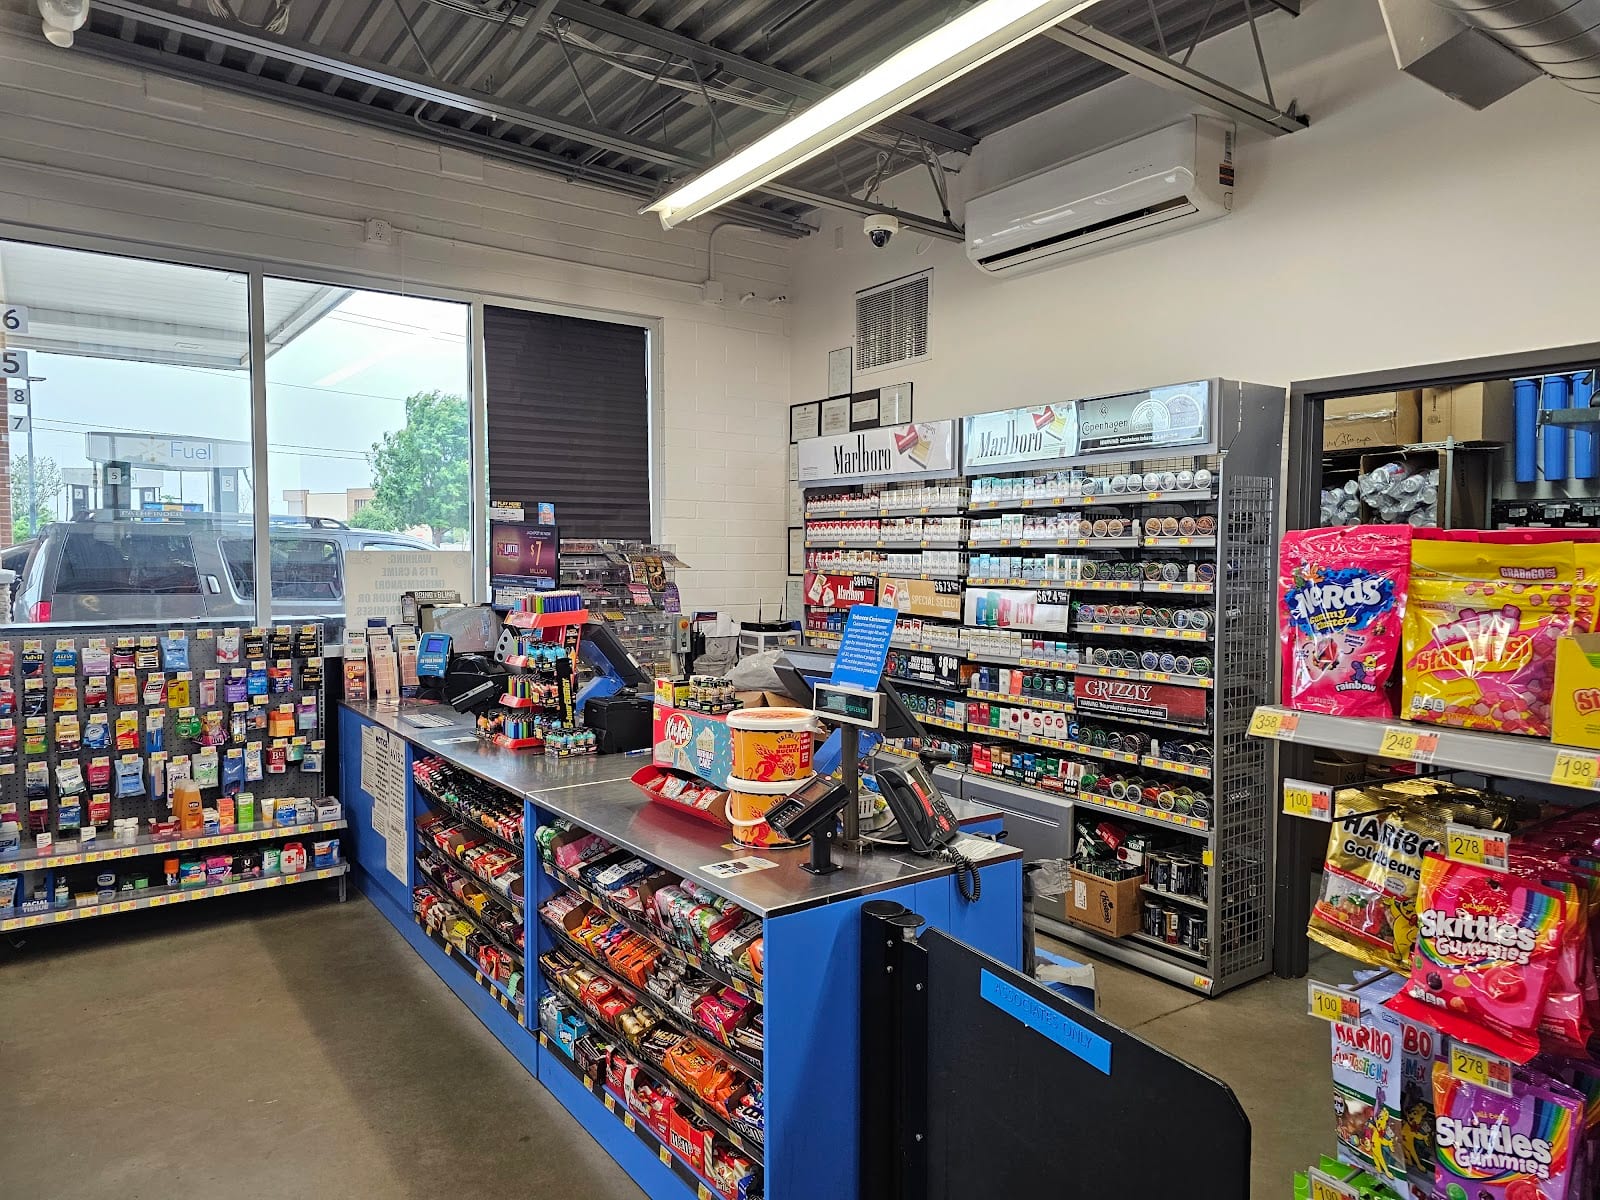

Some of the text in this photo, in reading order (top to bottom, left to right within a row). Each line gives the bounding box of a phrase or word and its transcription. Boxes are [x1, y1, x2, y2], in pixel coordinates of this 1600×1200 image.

[2, 309, 20, 330] 6
[2, 353, 20, 374] 5
[14, 389, 25, 402] 8
[13, 417, 24, 430] 7
[1081, 418, 1129, 436] Copenhagen
[976, 419, 1043, 459] Marlboro
[170, 440, 212, 460] Fuel
[833, 433, 892, 475] Marlboro
[111, 472, 119, 480] 5
[120, 510, 184, 518] PATHFINDER
[836, 581, 866, 603] Marlboro
[911, 594, 959, 609] SPECIAL SELECT
[907, 661, 936, 673] SAME CRUSH
[1084, 679, 1153, 702] GRIZZLY
[1335, 680, 1377, 693] rainbow
[375, 735, 388, 749] NOTICE
[699, 757, 713, 770] CAKE
[1343, 839, 1421, 882] Goldbears
[22, 900, 48, 908] FACIAL
[23, 905, 49, 913] TISSUE
[1419, 908, 1540, 952] Skittles
[1435, 937, 1531, 966] Gummies
[994, 982, 1093, 1049] ASSOCIATES ONLY
[653, 1028, 686, 1046] HEATH
[1334, 1022, 1392, 1062] HARIBO
[1435, 1115, 1553, 1165] Skittles
[1454, 1146, 1550, 1180] Gummies
